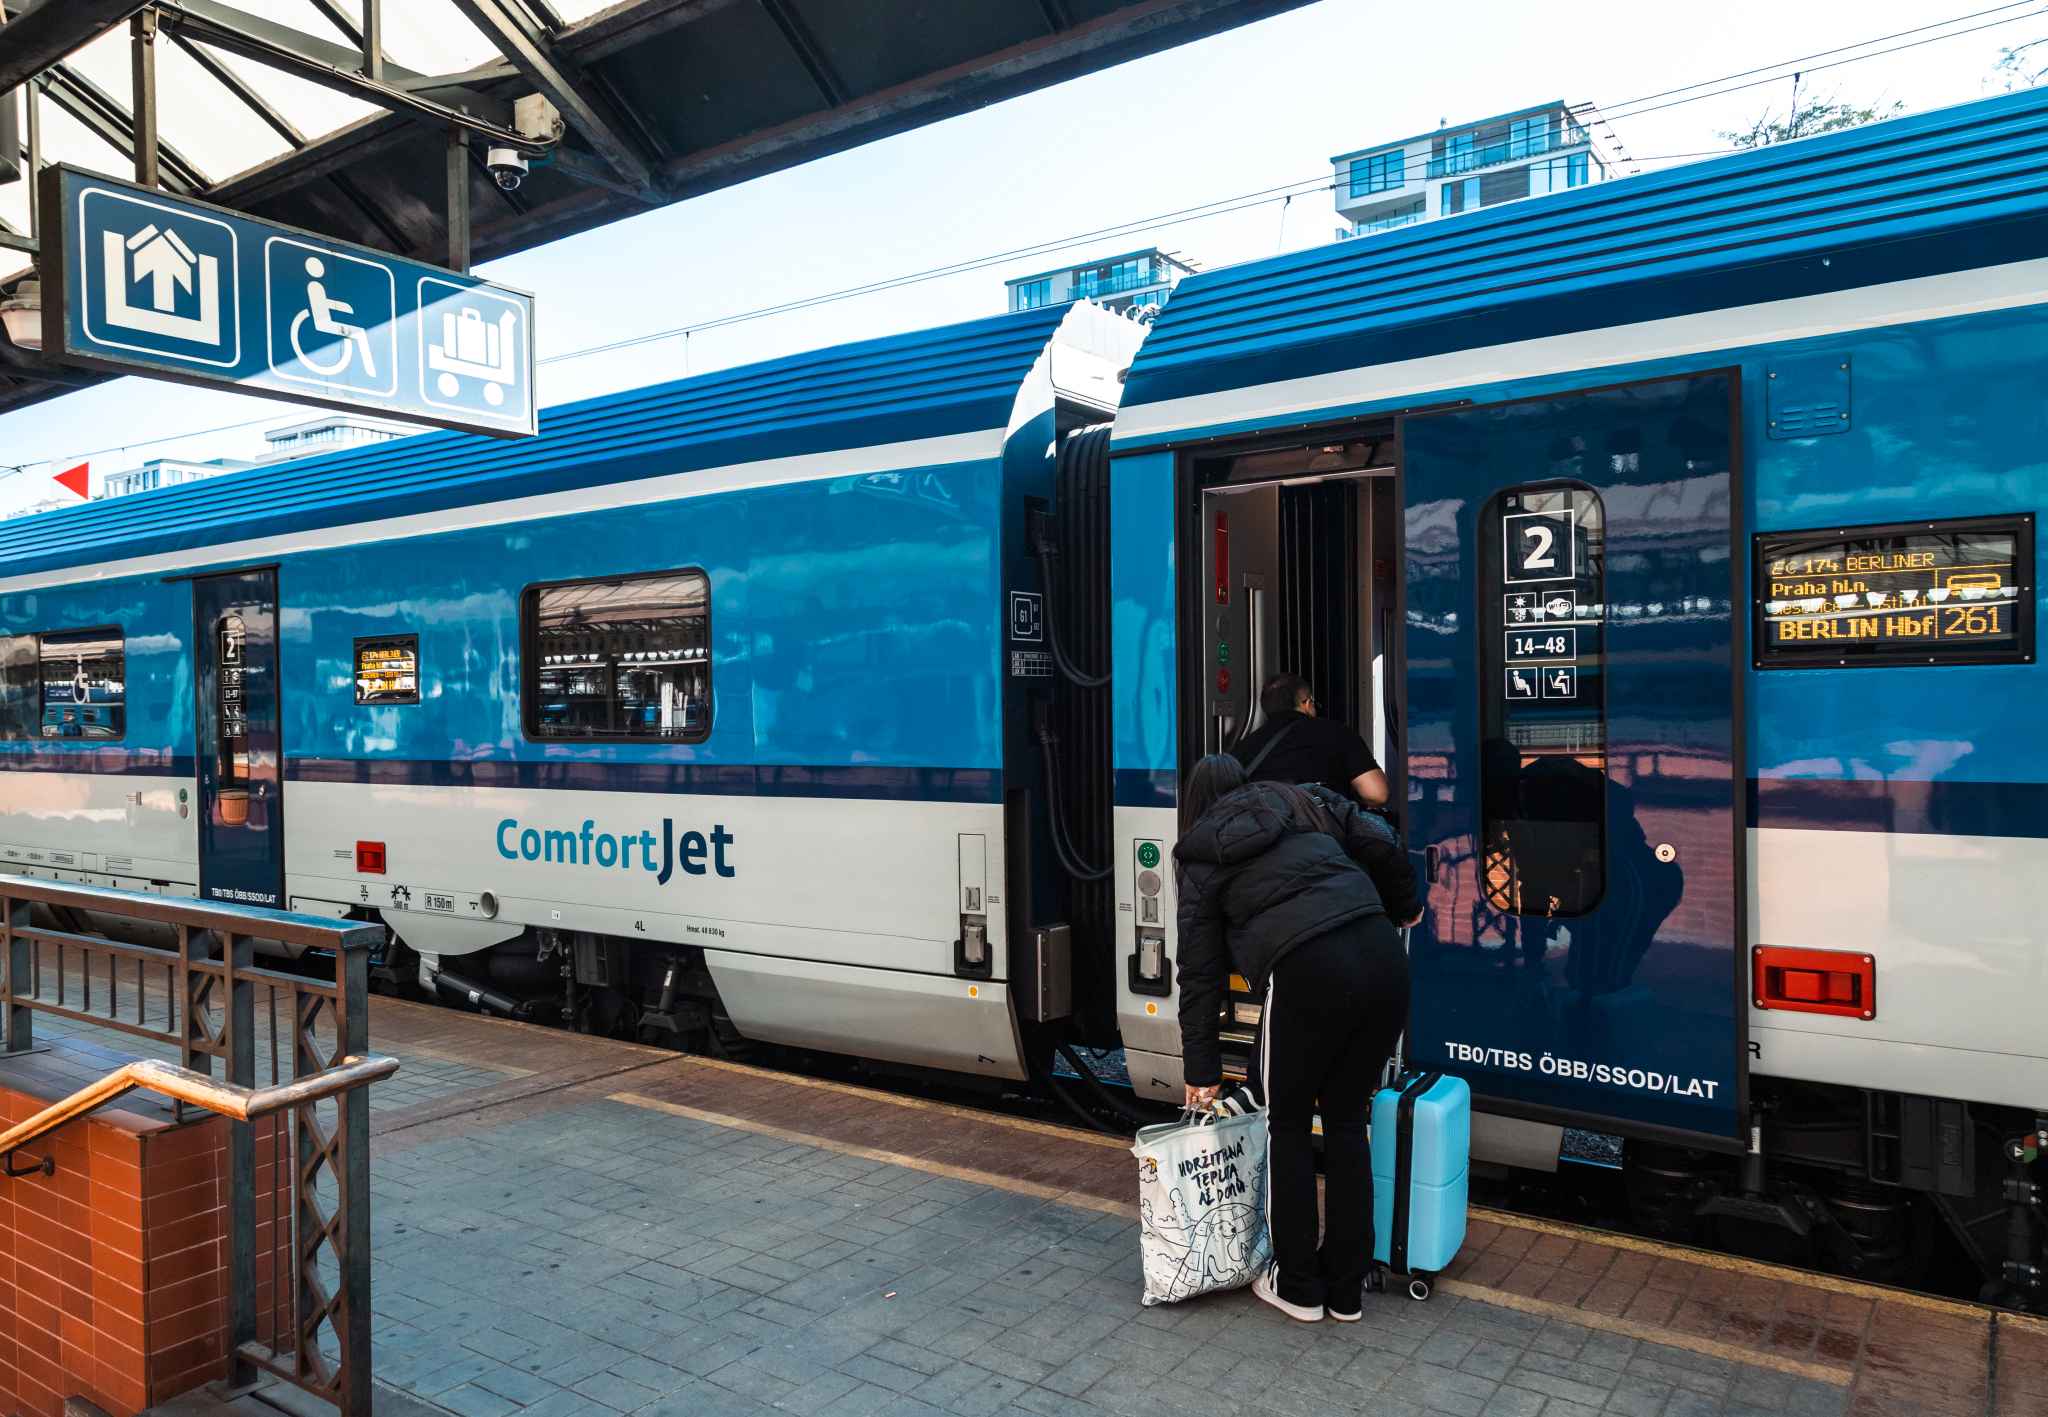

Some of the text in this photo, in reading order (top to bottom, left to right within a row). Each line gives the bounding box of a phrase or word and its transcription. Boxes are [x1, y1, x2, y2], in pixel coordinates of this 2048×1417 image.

[1523, 526, 1556, 570] 2
[1846, 552, 1935, 571] BERLINER
[1771, 580, 1827, 597] Praha
[1778, 615, 1935, 641] BERLIN Hbf
[1944, 606, 2002, 635] 261
[226, 637, 236, 658] 2
[497, 818, 736, 886] ComfortJet
[634, 920, 646, 932] 4L
[1539, 1051, 1719, 1100] ÖBB/SSOD/LAT
